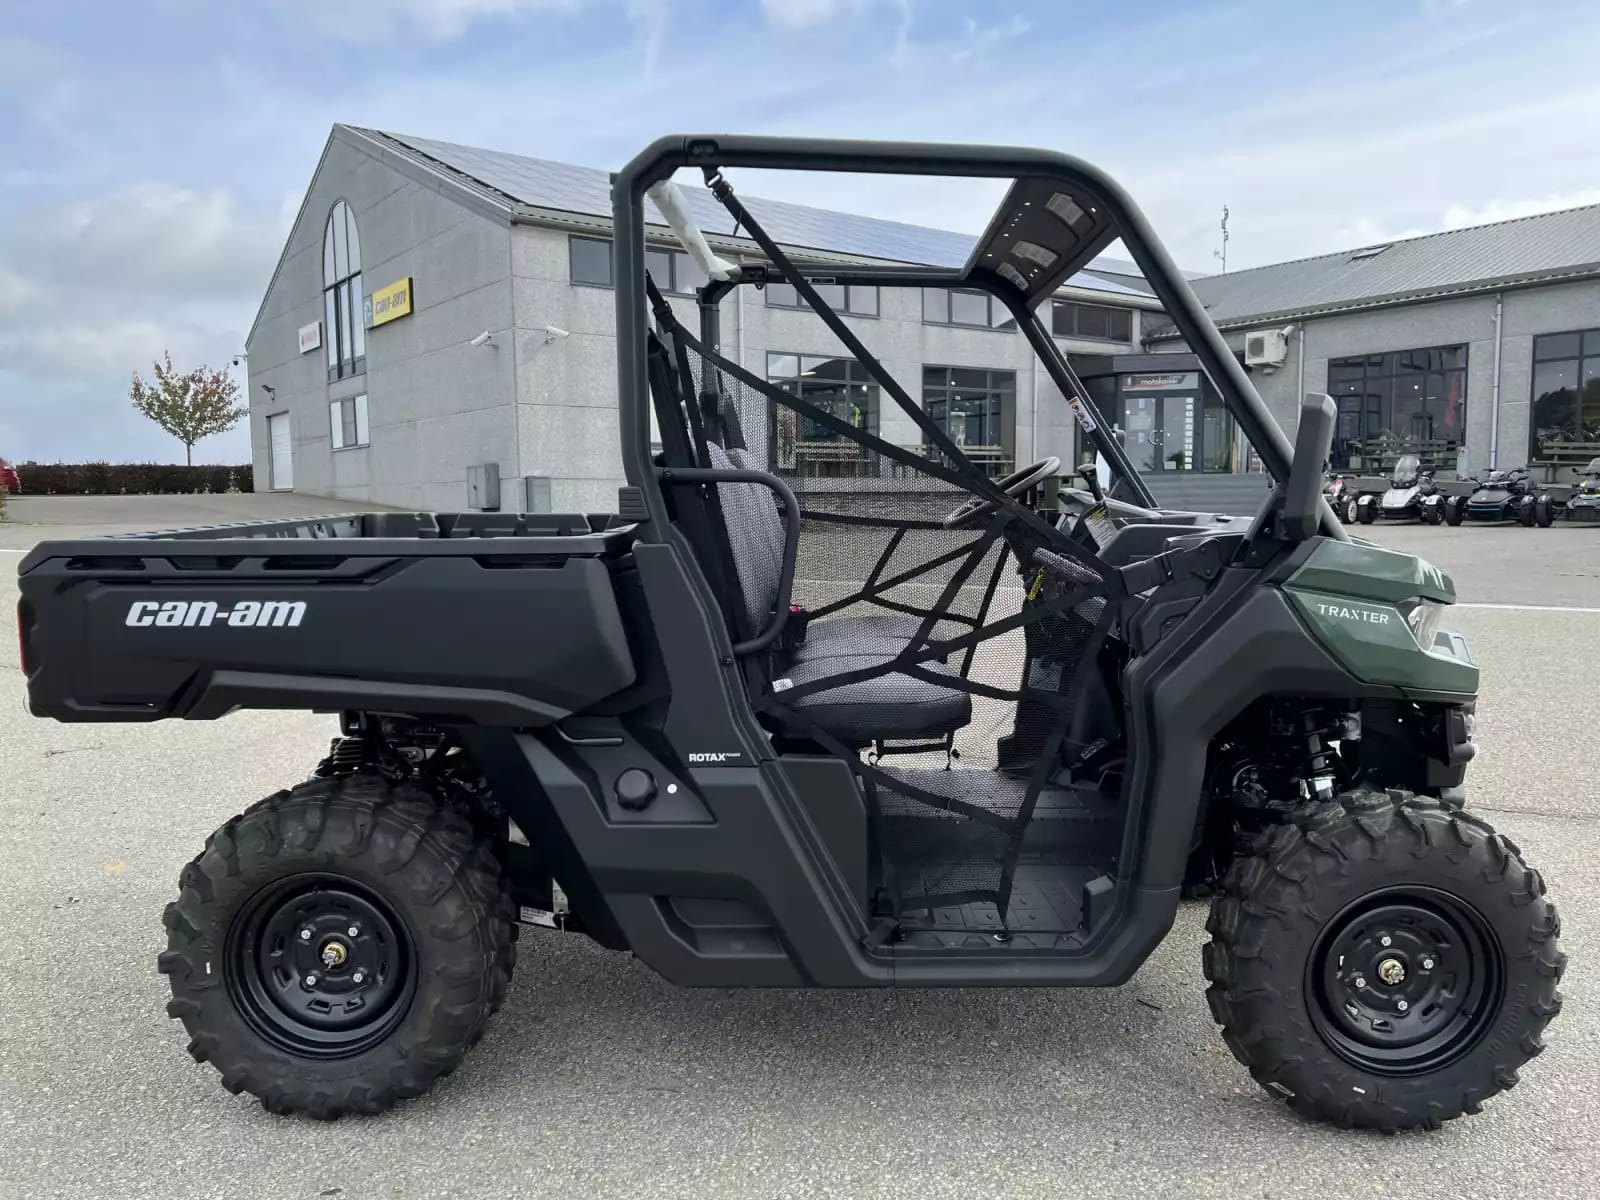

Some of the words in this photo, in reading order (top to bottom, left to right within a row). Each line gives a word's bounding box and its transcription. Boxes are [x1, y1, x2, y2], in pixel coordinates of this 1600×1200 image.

[125, 601, 307, 627] can-am
[1317, 603, 1389, 625] TRAXTER
[689, 753, 726, 762] ROTAX
